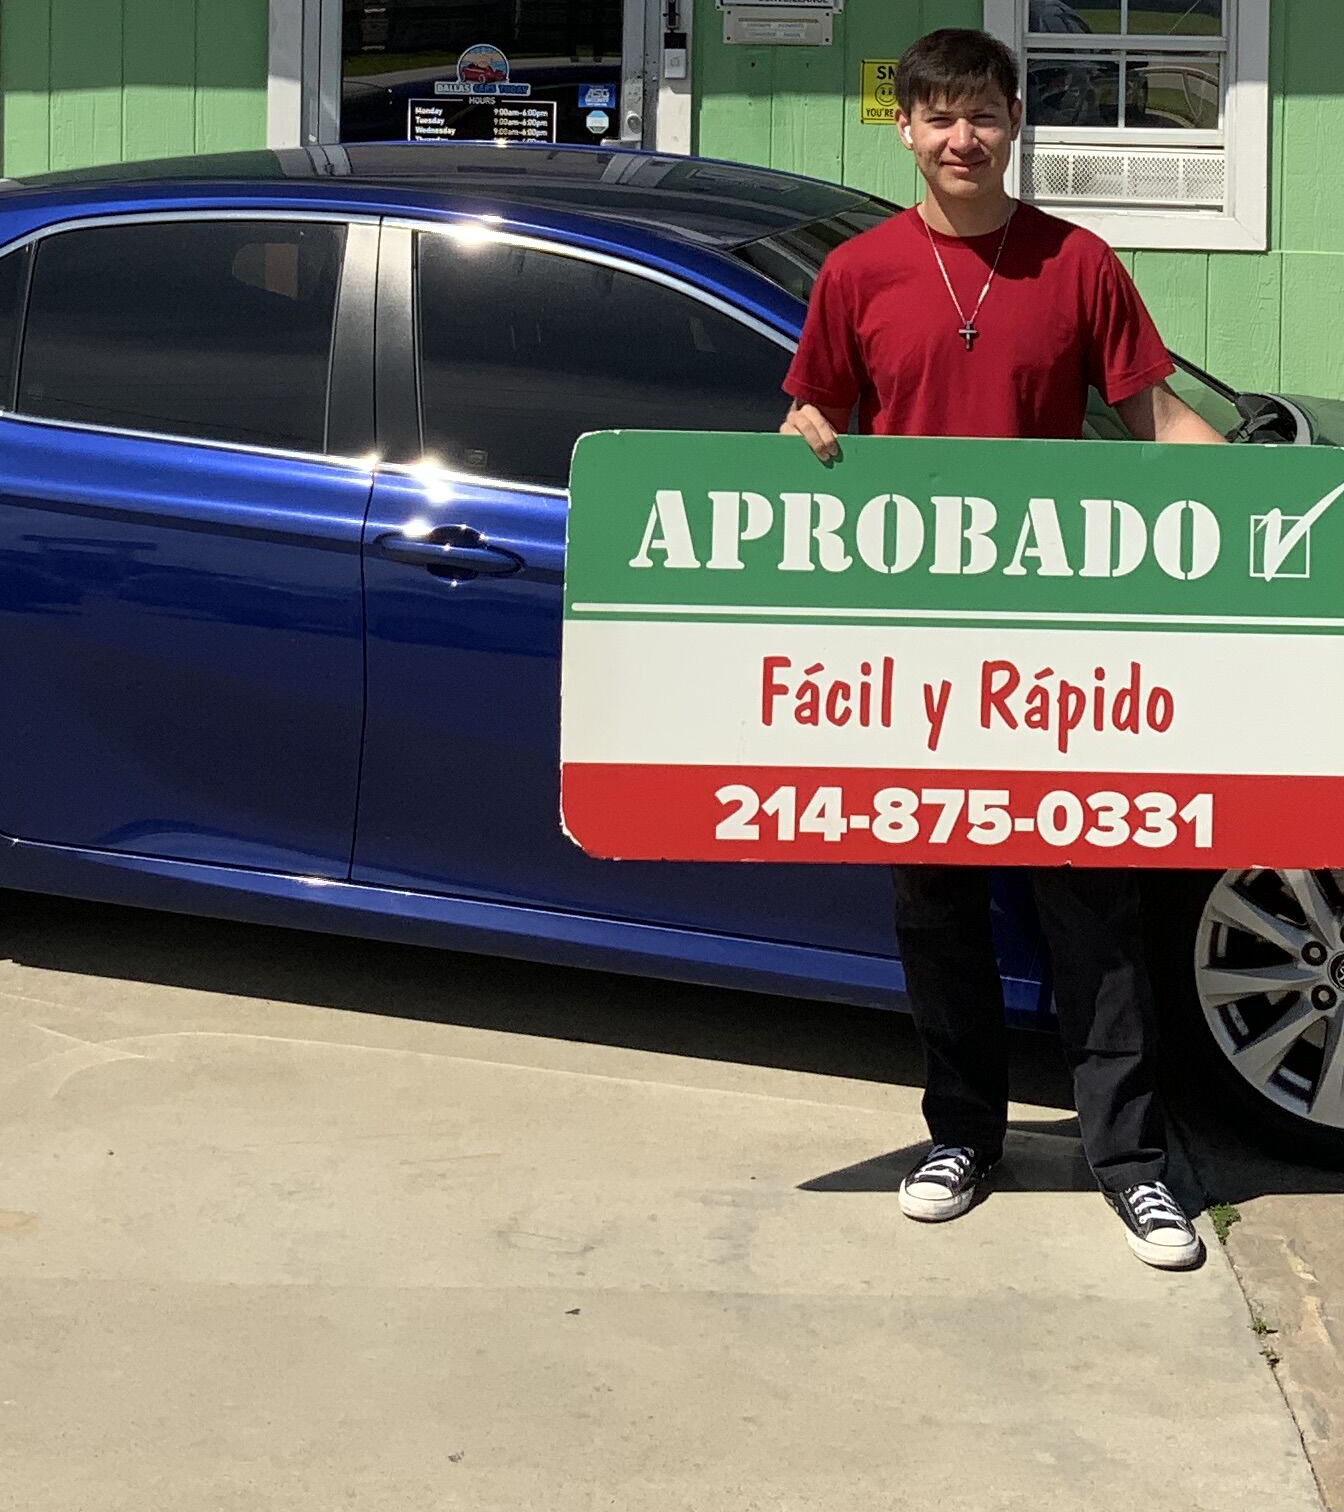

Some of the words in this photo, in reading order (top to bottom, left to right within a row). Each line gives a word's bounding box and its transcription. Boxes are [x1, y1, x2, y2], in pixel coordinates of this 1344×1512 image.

[437, 84, 470, 93] DALLAS
[468, 97, 496, 105] HOURS
[415, 106, 443, 116] Monday
[866, 108, 894, 118] YOU'RE
[415, 116, 445, 126] Tuesday
[415, 126, 456, 136] Wednesday
[628, 488, 1222, 582] APROBADO
[761, 656, 894, 730] Fácil
[923, 678, 952, 752] y
[981, 659, 1175, 755] Rápido
[714, 784, 1214, 849] 214-875-0331
